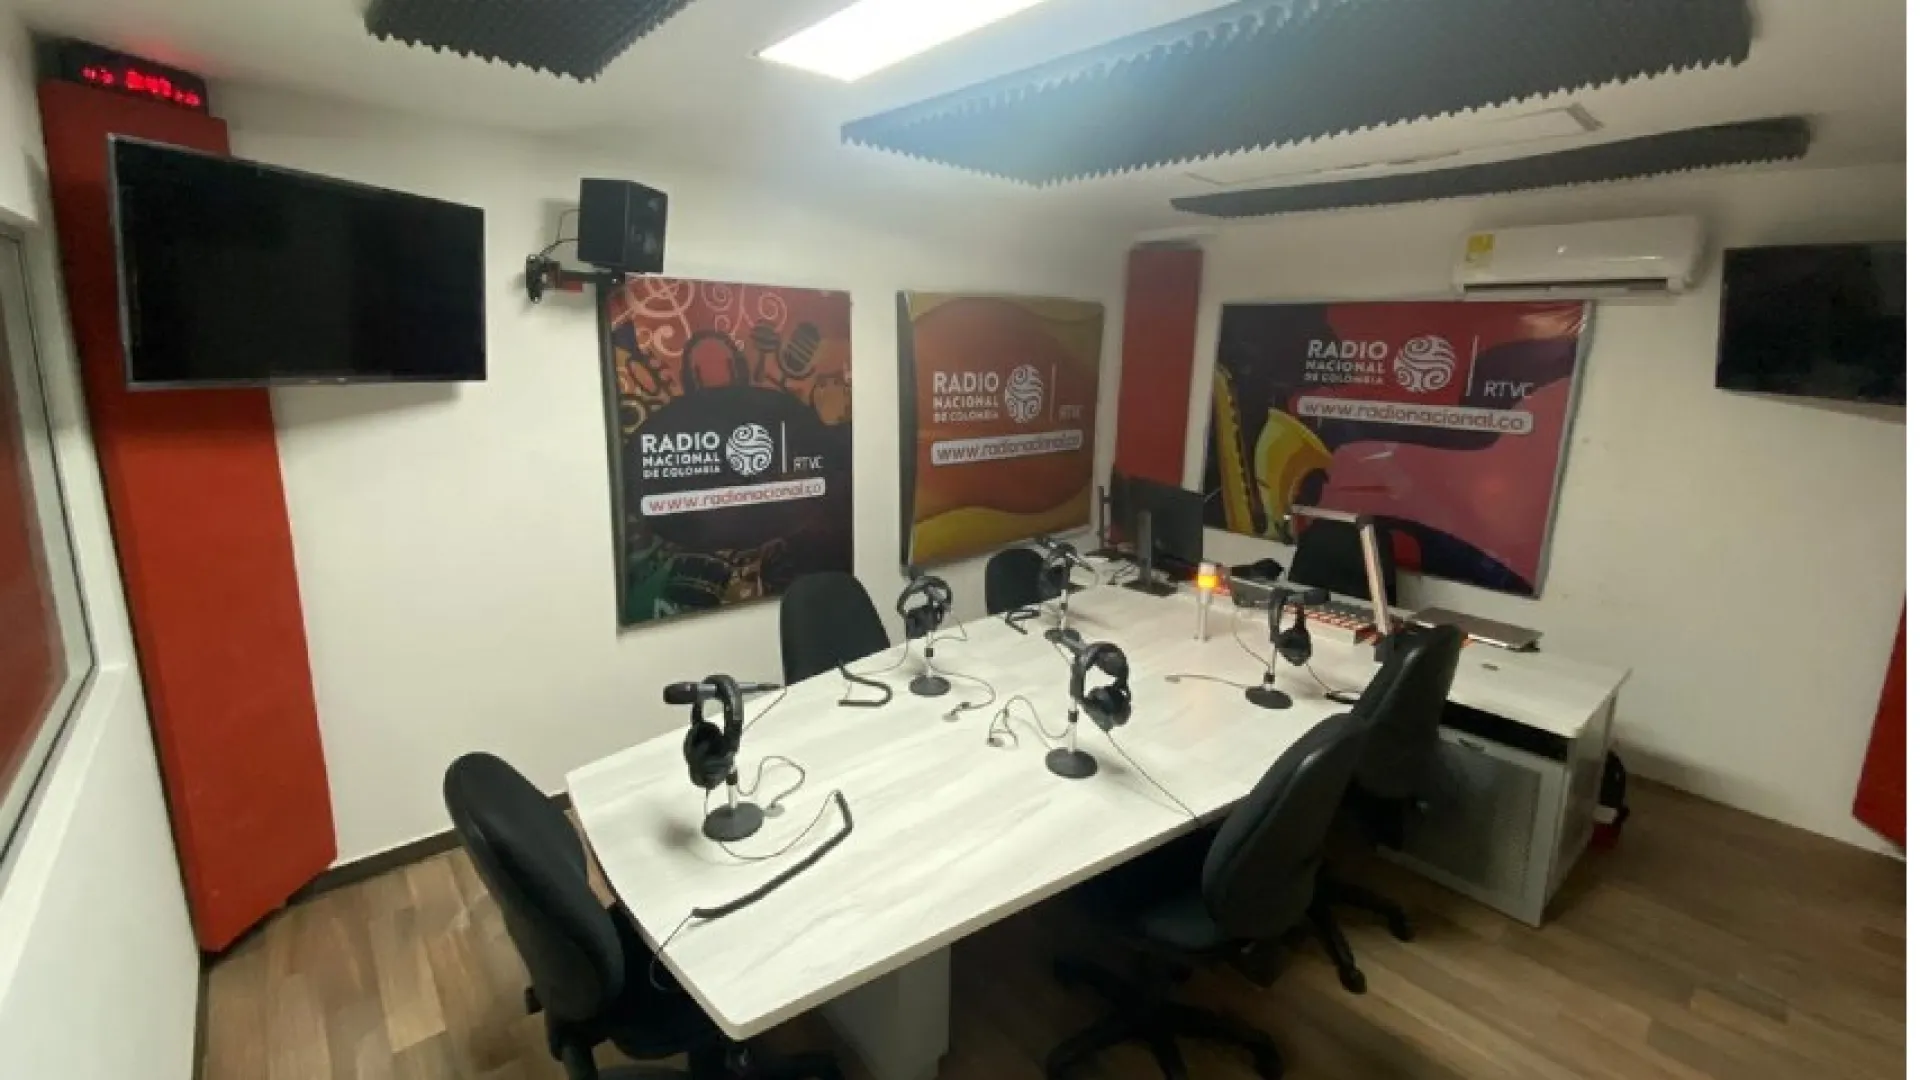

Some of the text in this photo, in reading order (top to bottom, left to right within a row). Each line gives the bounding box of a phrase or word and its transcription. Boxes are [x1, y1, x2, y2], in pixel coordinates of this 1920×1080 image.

[1307, 339, 1388, 359] RADIO
[1305, 359, 1386, 374] NACIONAL
[933, 370, 999, 393] RADIO
[1321, 372, 1384, 385] COLOMBIA
[1483, 379, 1534, 398] RTVC
[933, 395, 999, 409] NACIONAL
[1304, 401, 1525, 431] www.radionacional.co
[641, 431, 720, 453] RADIO
[642, 451, 720, 467] NACIONAL
[642, 465, 721, 479] DE COLOMBIA
[650, 482, 822, 512] www.radionacional.co
